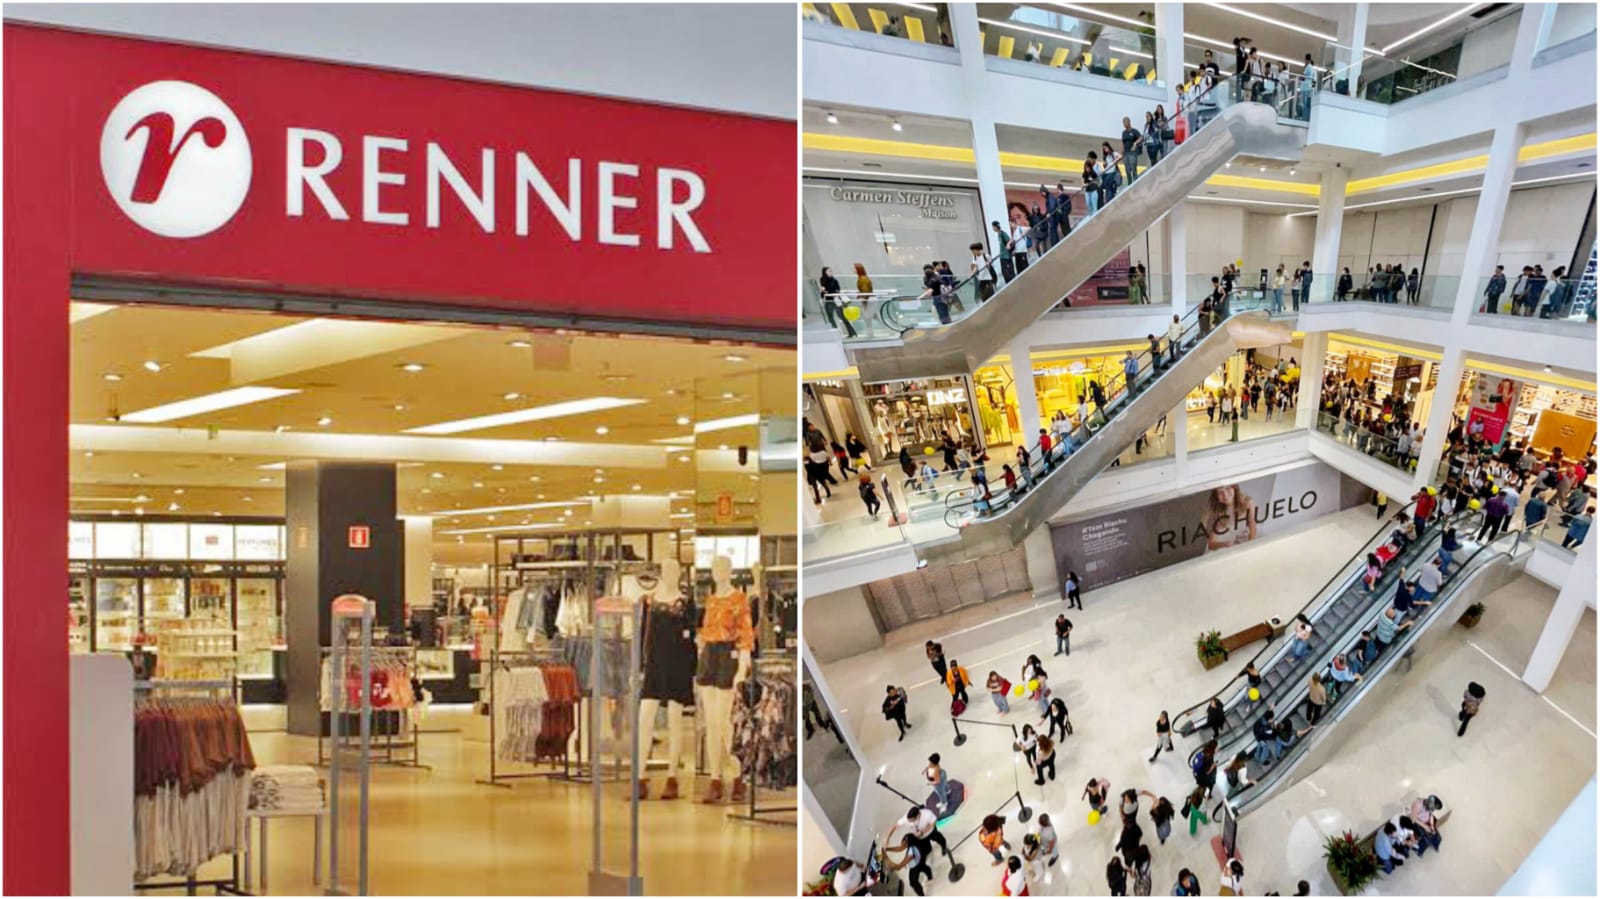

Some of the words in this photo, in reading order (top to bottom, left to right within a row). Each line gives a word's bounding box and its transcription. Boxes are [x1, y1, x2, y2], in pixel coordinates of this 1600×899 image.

[124, 111, 227, 204] r
[285, 126, 712, 253] RENNER
[830, 187, 892, 203] Carmen
[897, 191, 954, 207] Steffens
[921, 207, 957, 219] Maison
[1157, 490, 1318, 553] RIACHUELO
